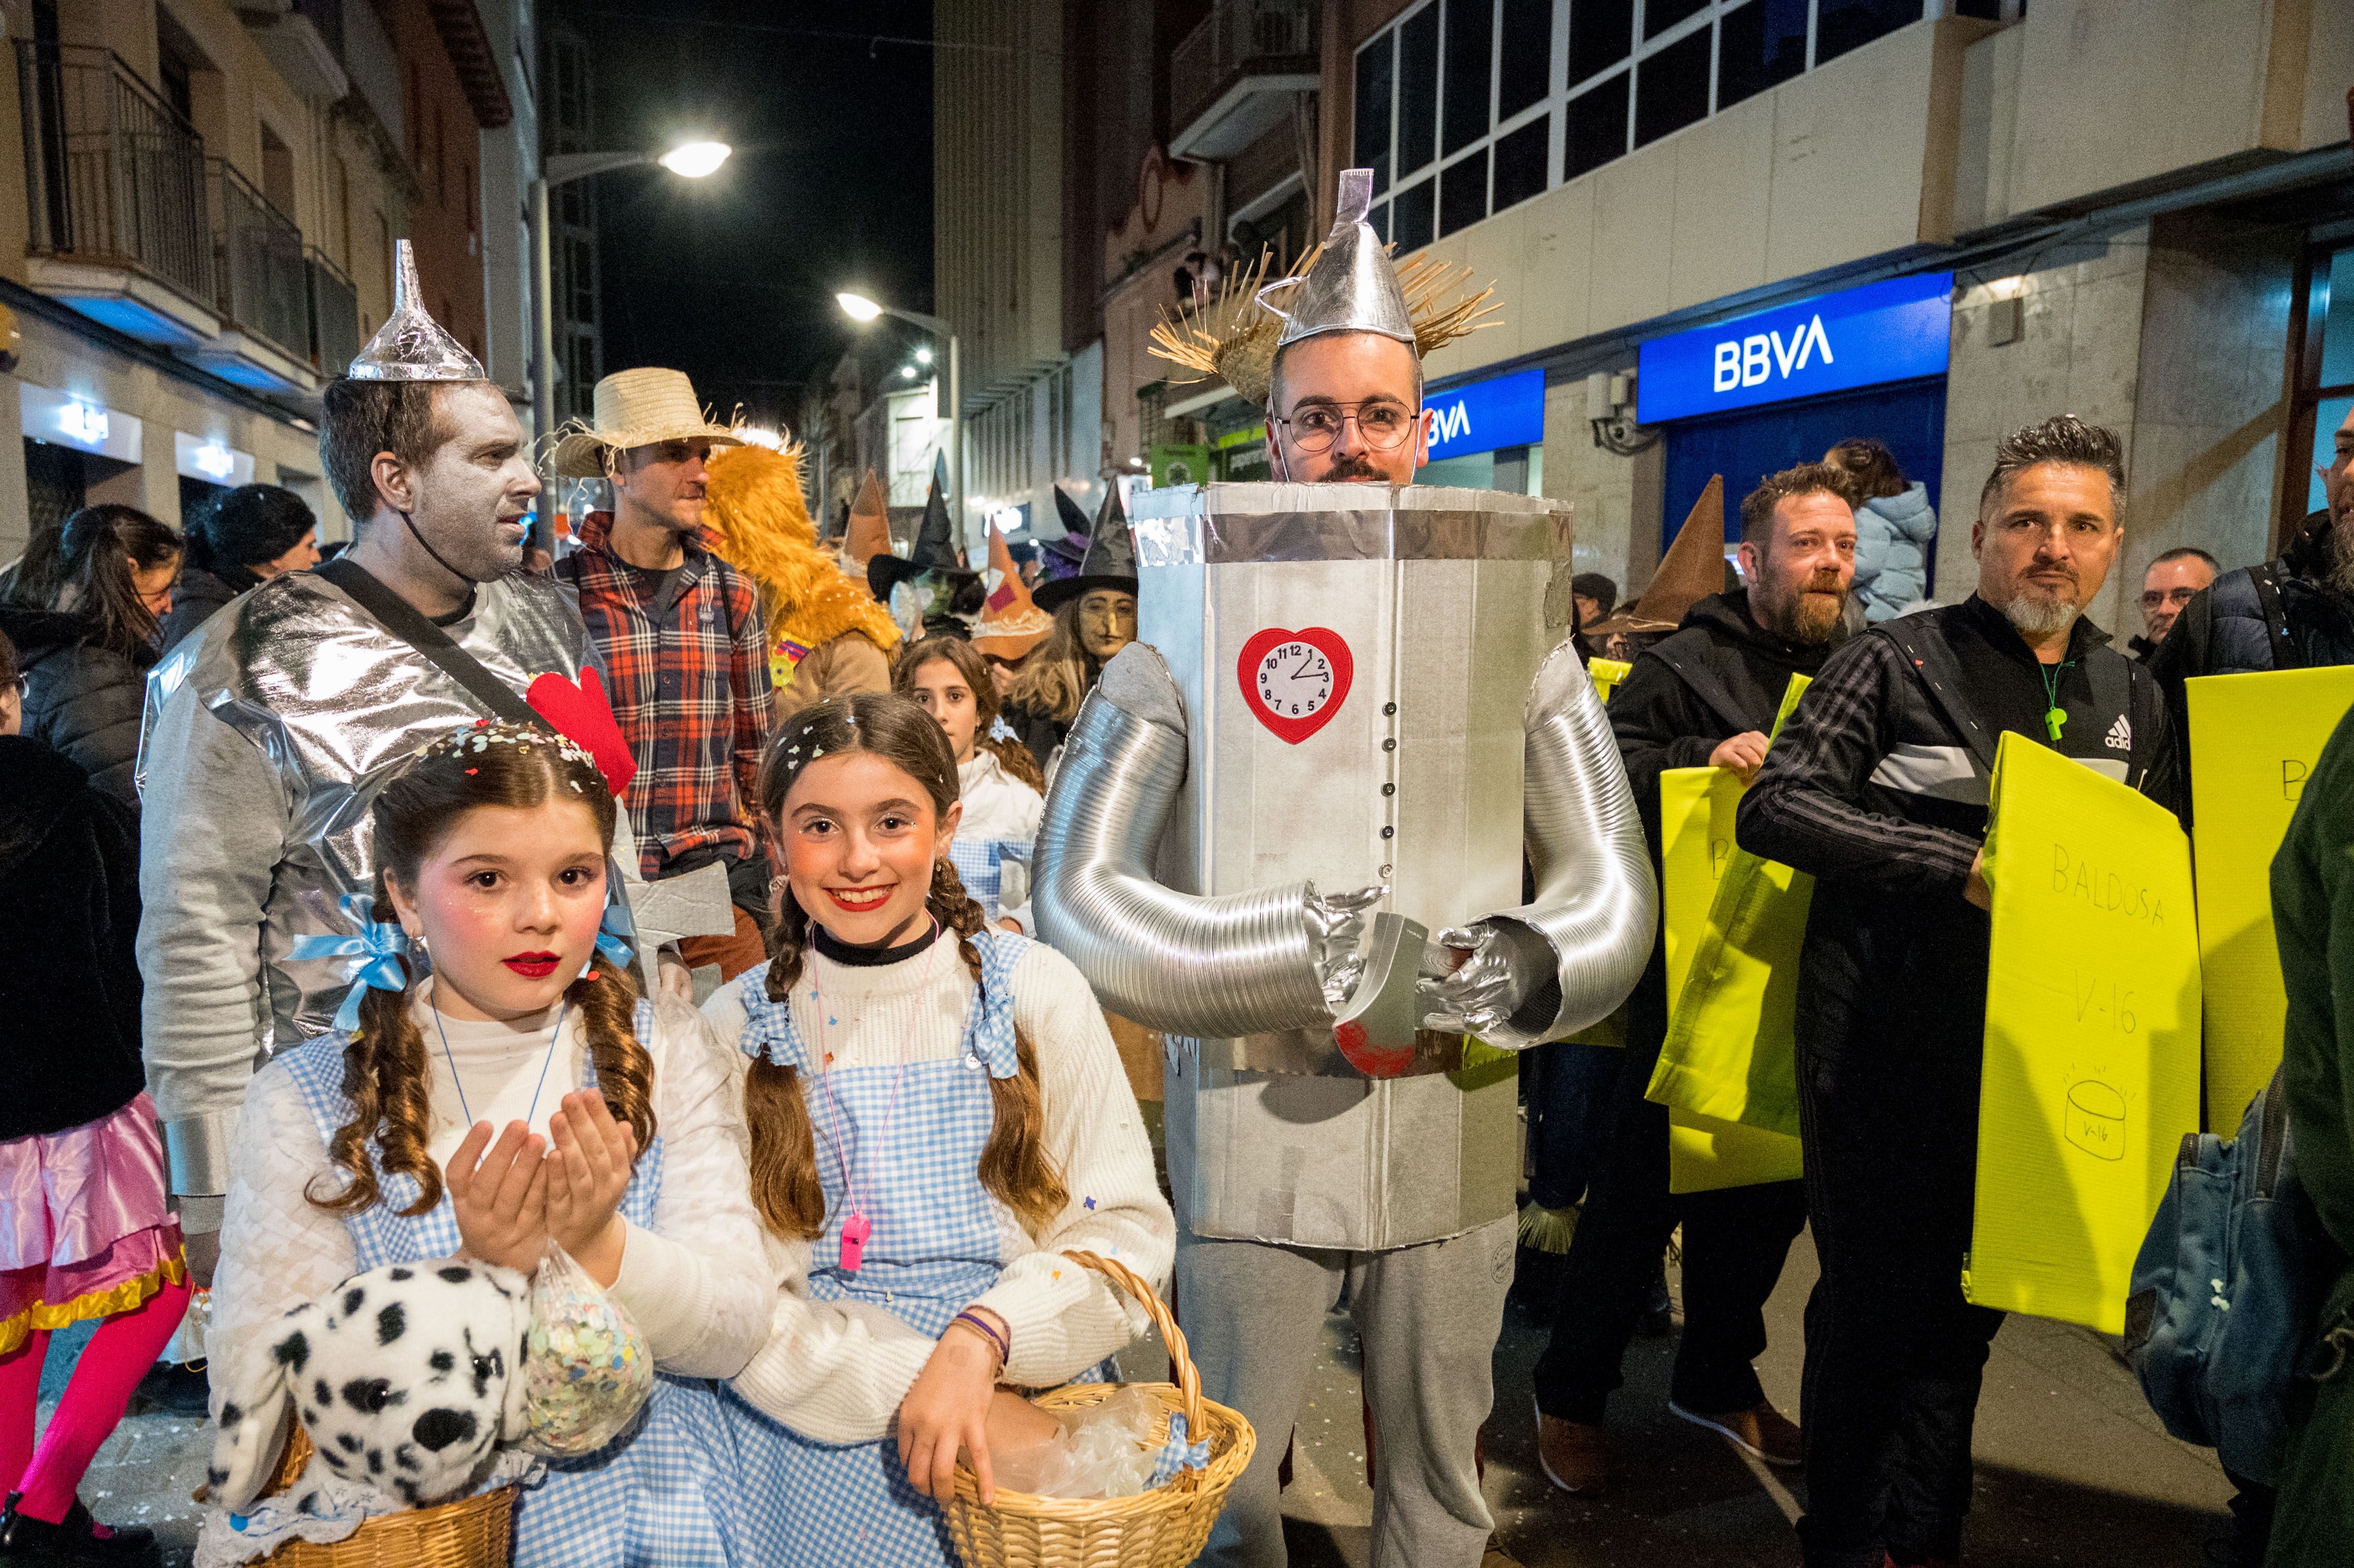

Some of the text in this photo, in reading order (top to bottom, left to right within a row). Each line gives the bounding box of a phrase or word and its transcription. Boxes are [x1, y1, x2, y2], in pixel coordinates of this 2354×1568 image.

[1714, 313, 1834, 393] BBVA
[1277, 648, 1287, 659] 11
[1289, 645, 1301, 656] 12
[1307, 648, 1313, 659] 1
[1265, 658, 1277, 669] 10
[1317, 658, 1325, 669] 2
[1260, 673, 1267, 684] 9
[1322, 672, 1329, 682] 3
[1264, 689, 1271, 700] 8
[1318, 688, 1326, 699] 4
[1274, 699, 1281, 710] 7
[1291, 703, 1299, 714] 6
[1307, 700, 1314, 711] 5
[2053, 843, 2164, 927] BALDOSA
[2075, 969, 2136, 1034] V-16
[2083, 1120, 2108, 1142] V-16
